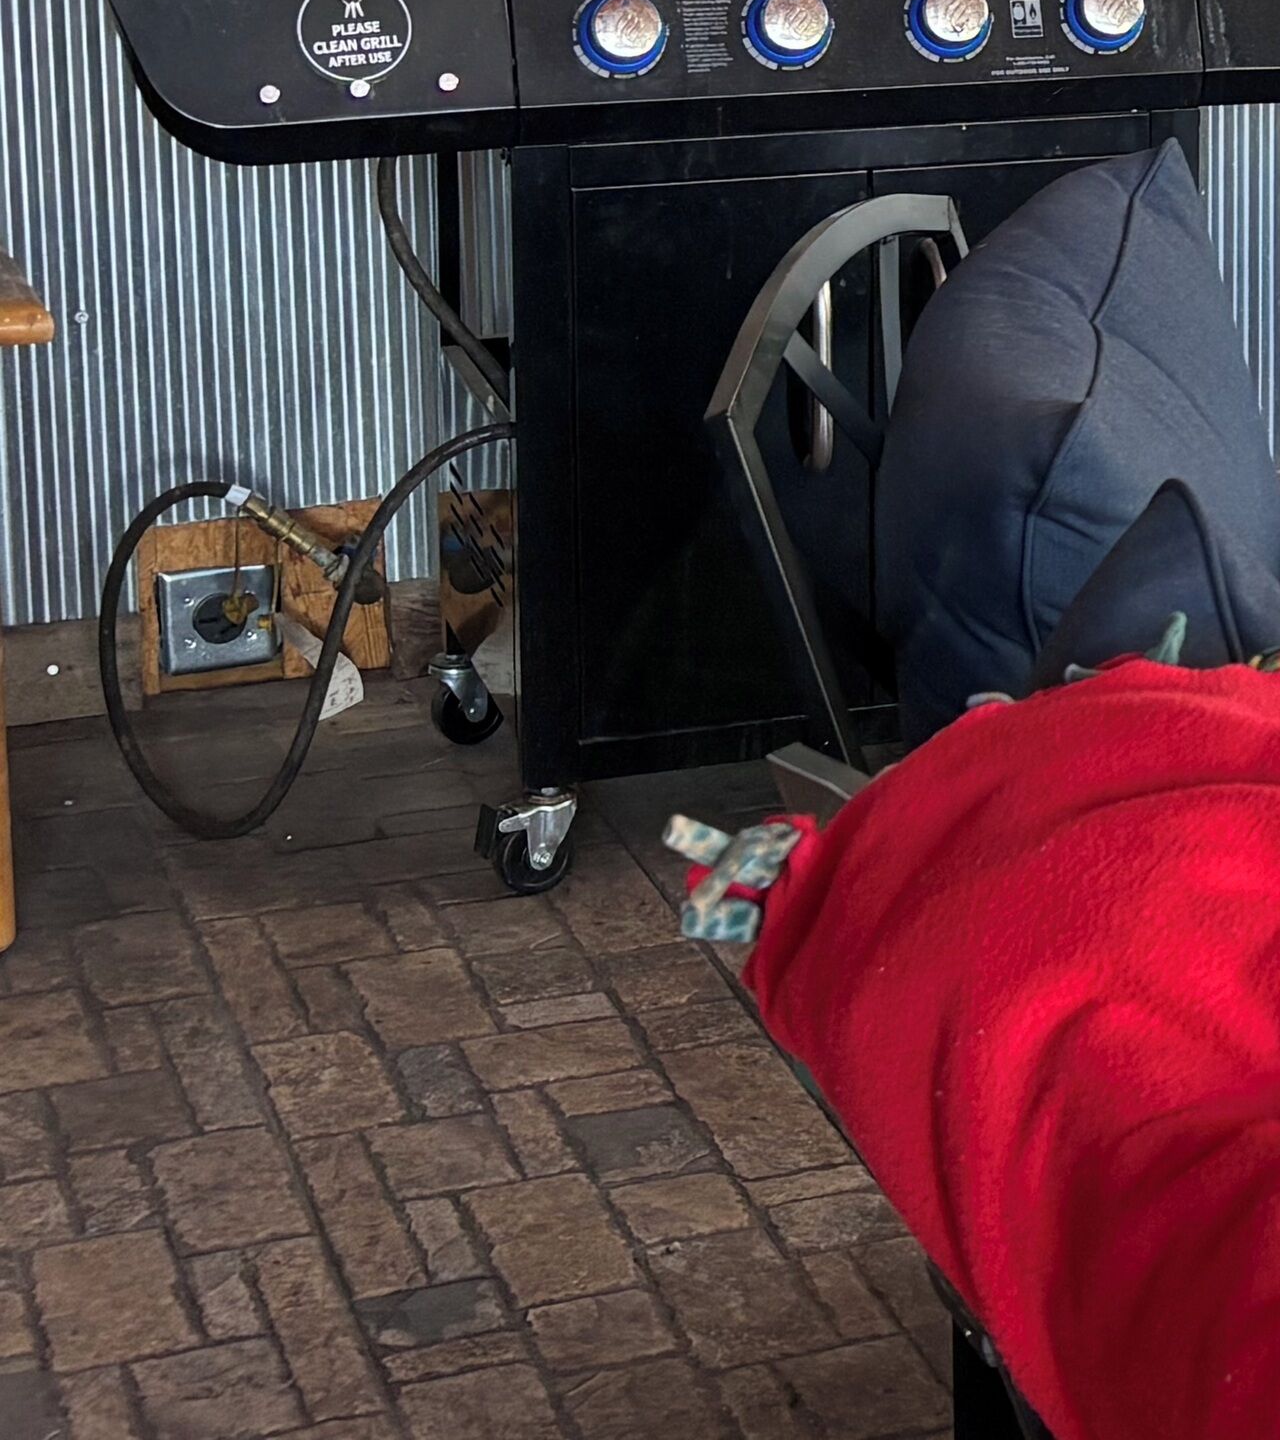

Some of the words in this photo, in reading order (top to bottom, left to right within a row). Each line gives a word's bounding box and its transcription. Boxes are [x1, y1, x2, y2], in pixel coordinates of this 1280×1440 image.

[331, 20, 381, 37] PLEASE
[313, 38, 358, 55] CLEAN
[360, 35, 403, 50] GRILL
[329, 53, 366, 68] AFTER
[368, 51, 392, 63] USE
